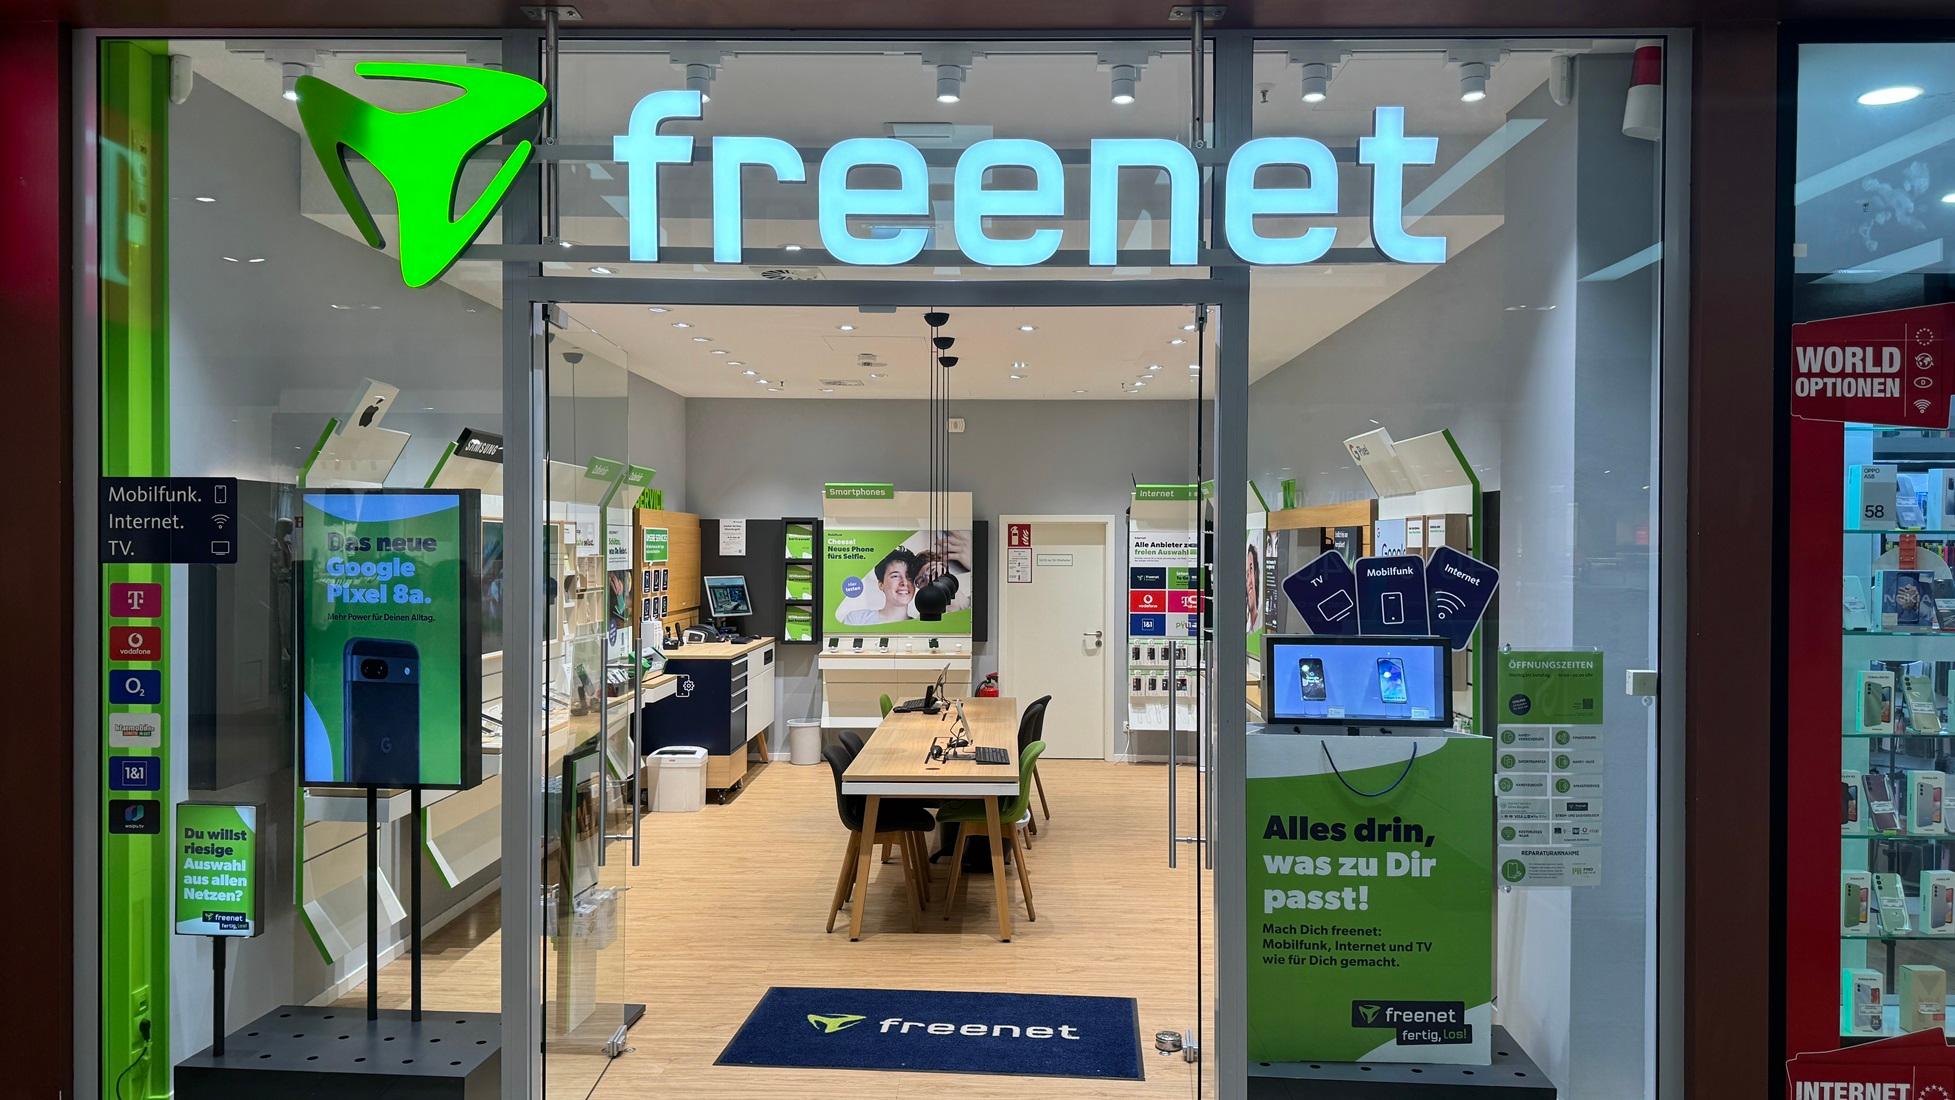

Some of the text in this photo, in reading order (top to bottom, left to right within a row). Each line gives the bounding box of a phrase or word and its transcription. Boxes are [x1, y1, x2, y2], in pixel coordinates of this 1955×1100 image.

[612, 89, 1447, 266] freenet
[1796, 346, 1901, 373] WORLD
[1795, 377, 1900, 397] OPTIONEN
[108, 485, 202, 503] Mobilfunk.
[830, 488, 886, 497] Smartphones
[1864, 505, 1884, 518] 58
[108, 513, 185, 530] Internet.
[108, 541, 135, 556] TV.
[327, 532, 437, 552] Das neue
[326, 558, 415, 581] Google
[1366, 566, 1414, 577] Mobilfunk
[1444, 563, 1481, 587] Internet
[1310, 575, 1324, 588] TV
[327, 584, 432, 604] Pixel 8a.
[327, 613, 436, 623] Mehr Power für Deinen Alltag.
[1508, 659, 1594, 669] ÖFFNUNGSZEITEN
[125, 767, 144, 779] 1&1
[184, 827, 247, 841] Du willst
[1263, 815, 1435, 847] Alles drin,
[184, 843, 234, 857] riesige
[184, 858, 247, 871] Auswahl
[1263, 852, 1437, 877] was zu Dir
[184, 874, 247, 886] aus allen
[184, 888, 243, 902] Netzen?
[1263, 885, 1369, 914] passt!
[215, 913, 243, 922] freenet
[1262, 924, 1382, 937] Mach Dich freenet:
[1262, 939, 1432, 953] Mobilfunk, Internet und TV
[1262, 954, 1400, 969] wie für Dich gemacht.
[1385, 1007, 1457, 1023] freenet
[879, 1018, 1080, 1041] freenet
[1402, 1030, 1441, 1042] fertig,
[1795, 1082, 1911, 1100] INTERNET
